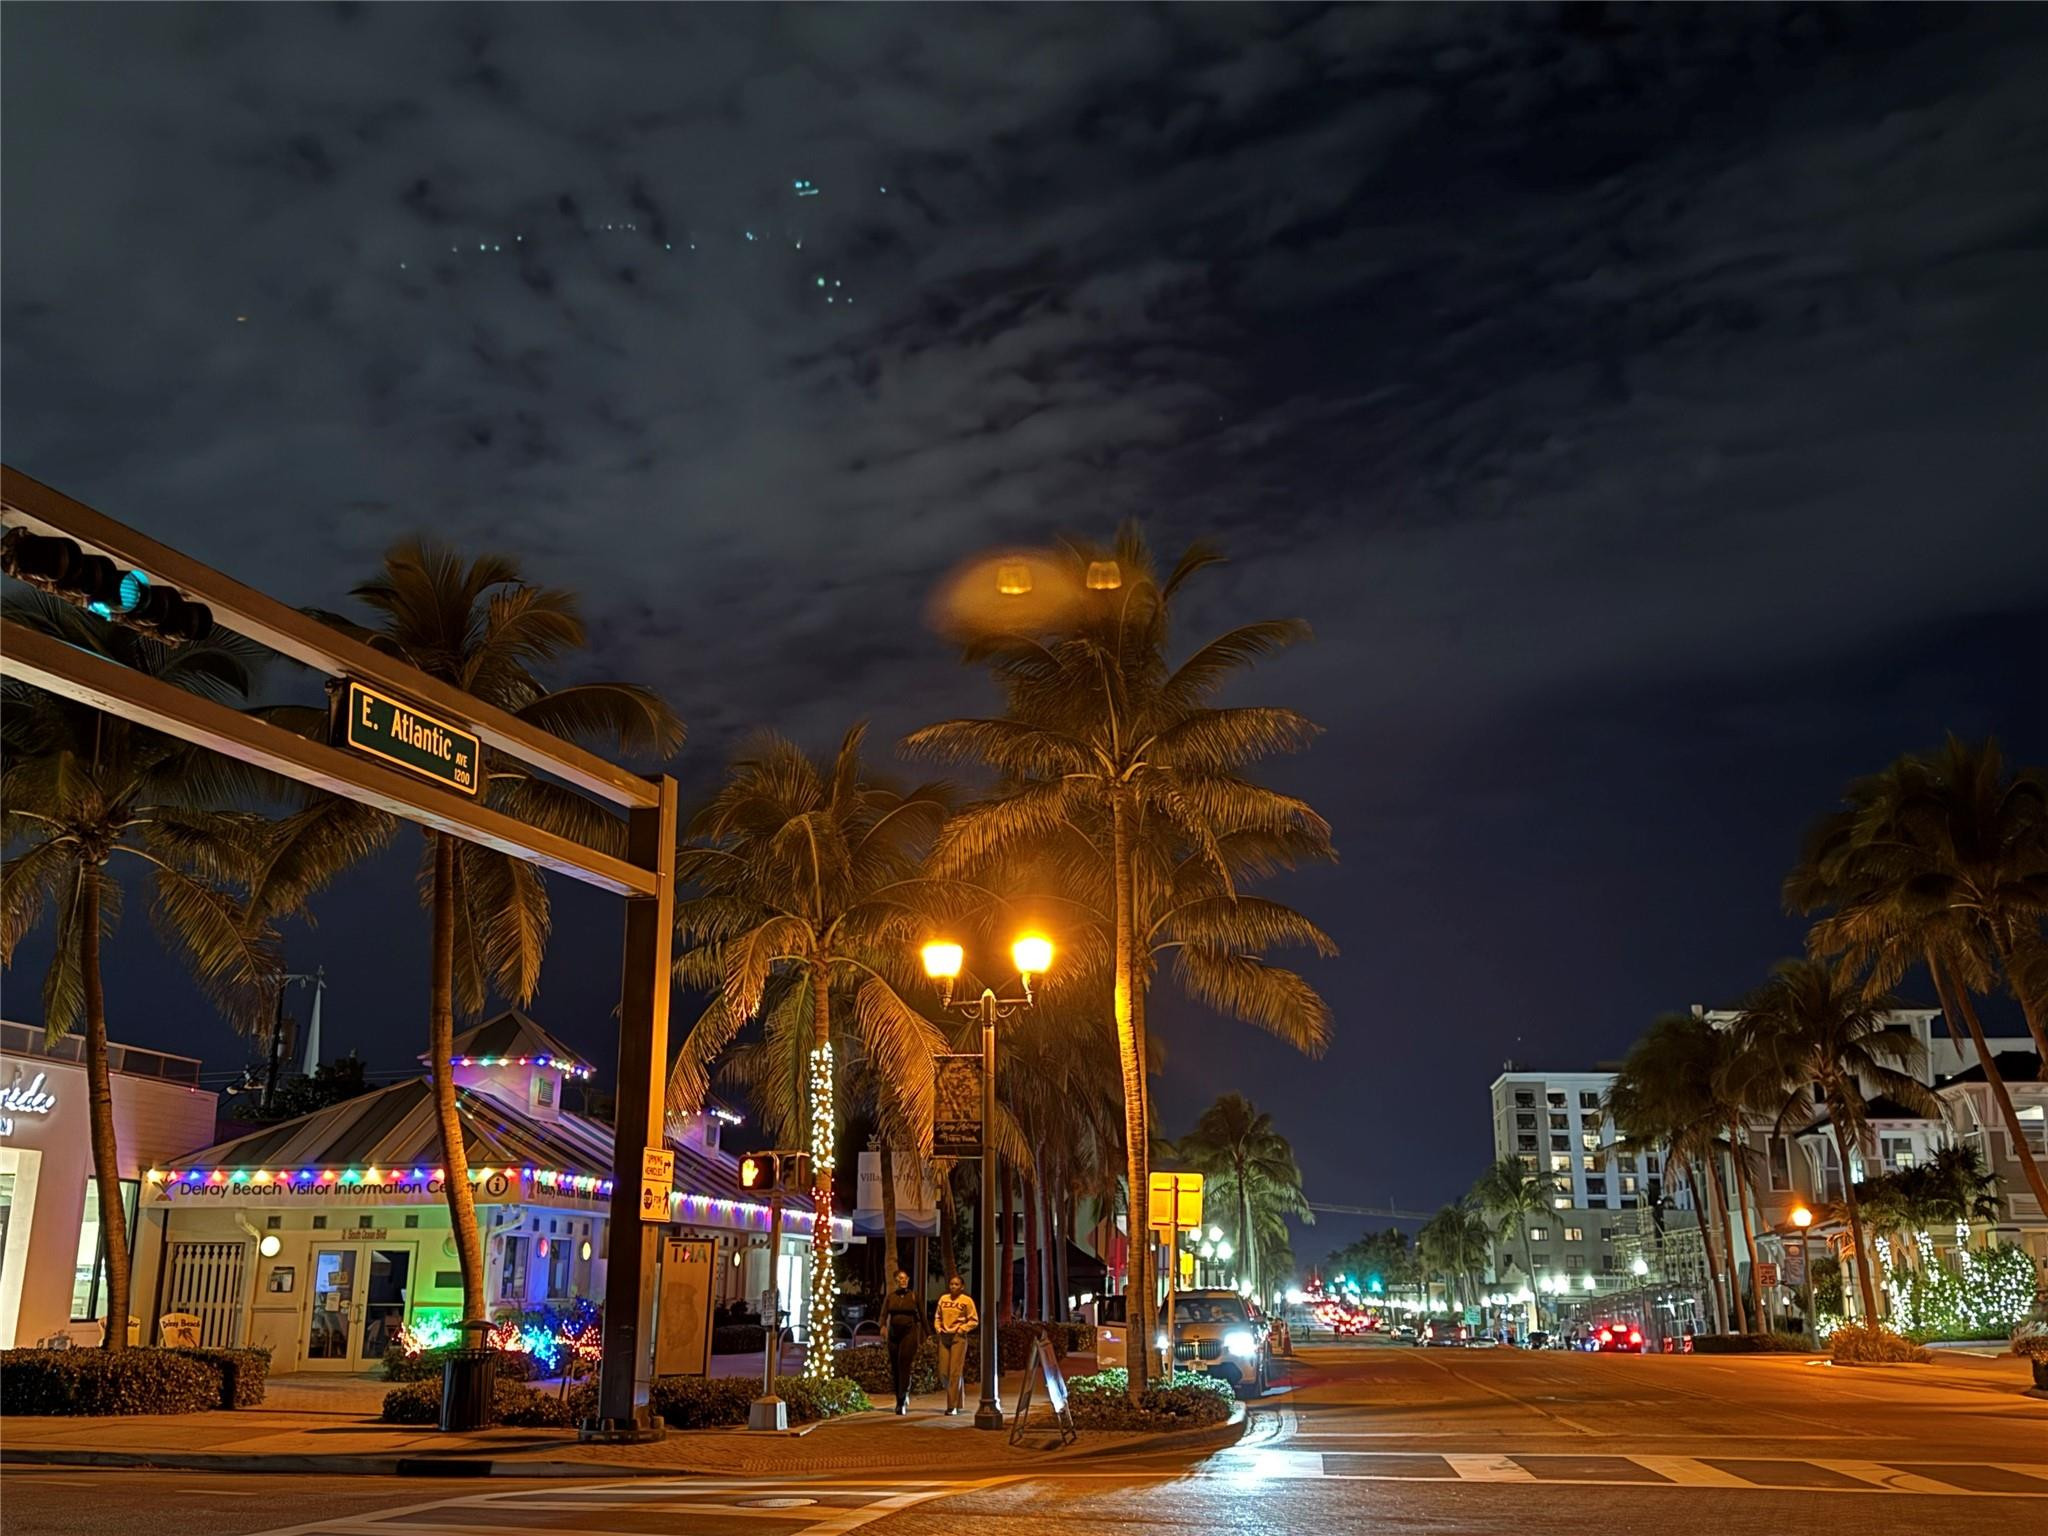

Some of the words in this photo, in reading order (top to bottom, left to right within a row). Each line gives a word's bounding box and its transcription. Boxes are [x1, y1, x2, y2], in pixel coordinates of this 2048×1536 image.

[362, 695, 379, 730] E.
[391, 709, 452, 760] Atlantic
[456, 753, 468, 768] AVE
[454, 768, 470, 785] 1200
[180, 1182, 229, 1198] Delray
[233, 1181, 282, 1195] Beach
[287, 1182, 331, 1195] Visitor
[334, 1181, 422, 1195] Information
[427, 1180, 481, 1194] Ceer
[1760, 1275, 1776, 1285] 25
[180, 1318, 200, 1328] Beach
